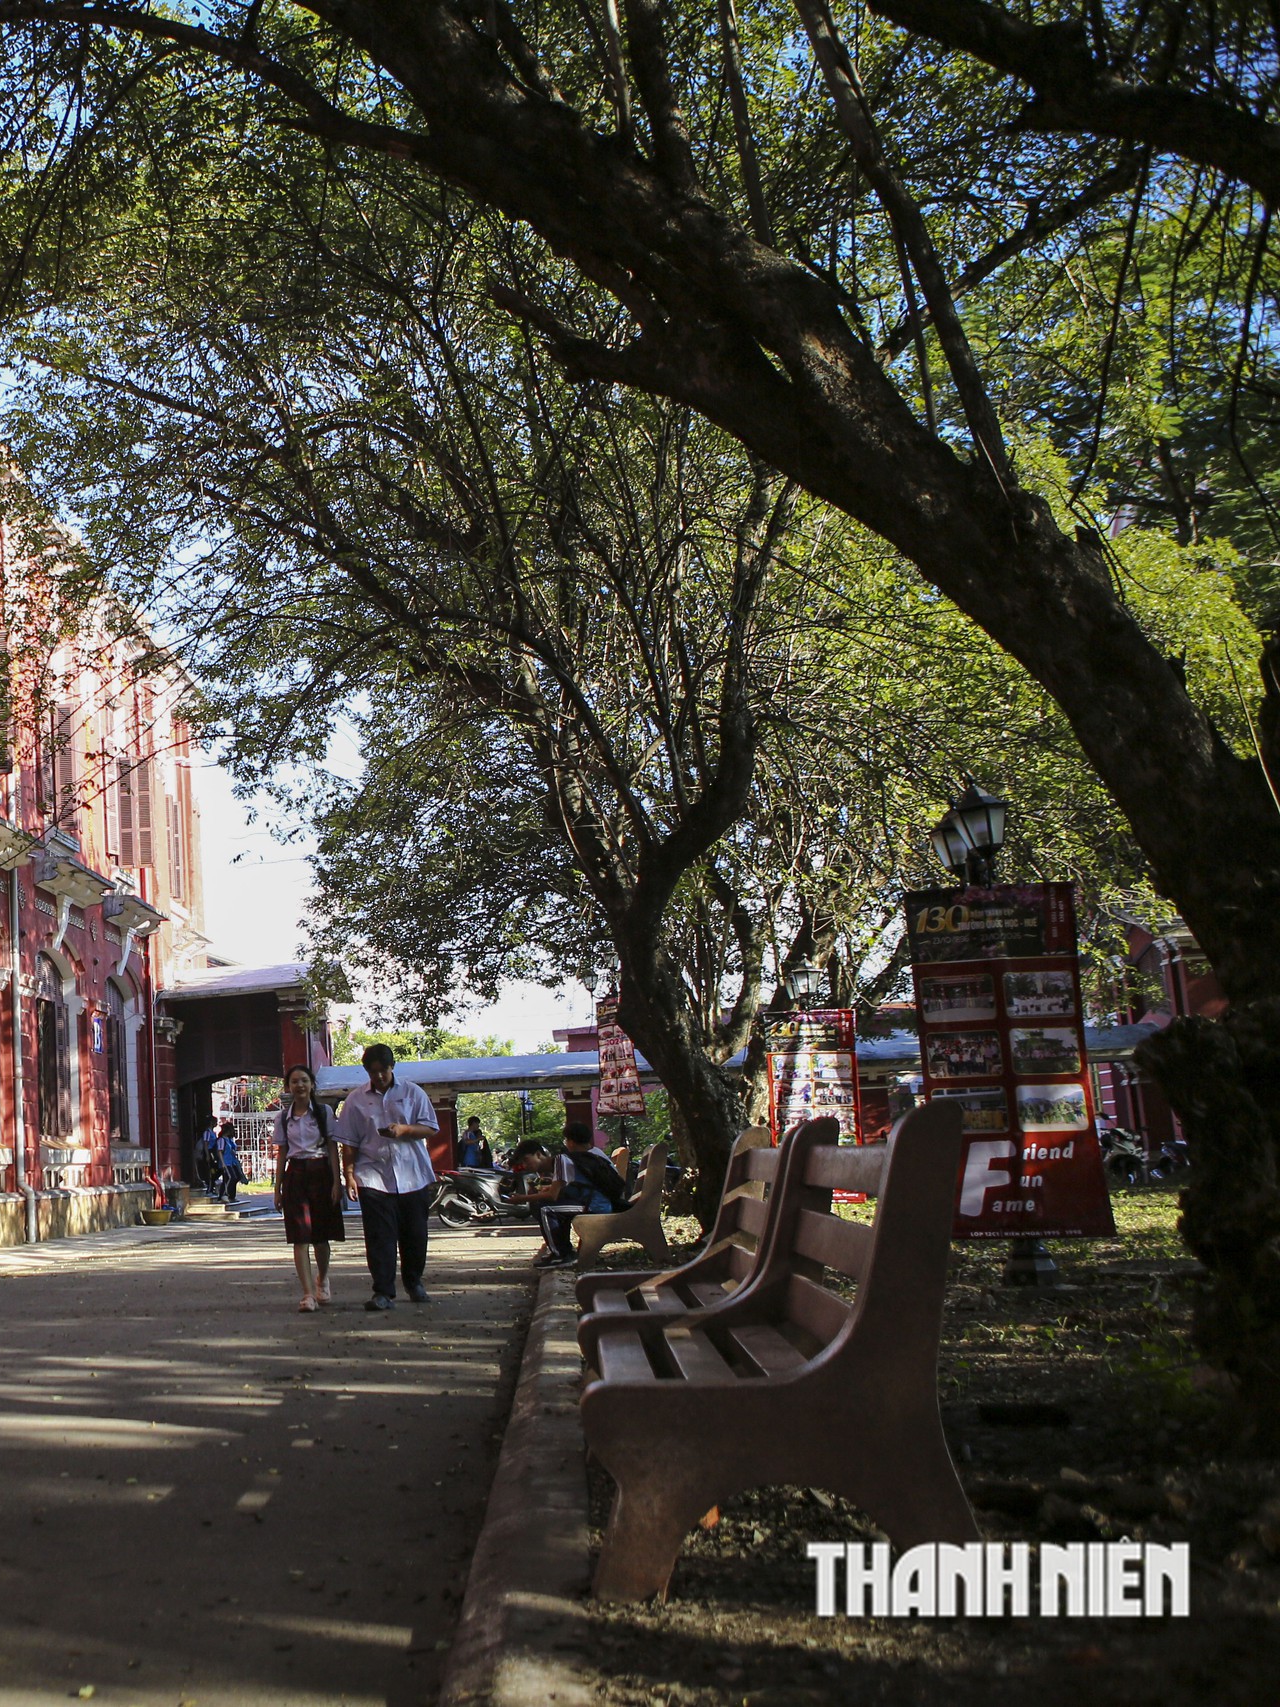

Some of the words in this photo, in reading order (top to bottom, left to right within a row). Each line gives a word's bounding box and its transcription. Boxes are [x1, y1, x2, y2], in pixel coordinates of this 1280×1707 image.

[915, 904, 971, 934] 130
[93, 1021, 101, 1050] B
[1022, 1140, 1075, 1161] riend
[959, 1140, 1017, 1217] F
[1020, 1174, 1043, 1188] un
[992, 1199, 1036, 1213] ame
